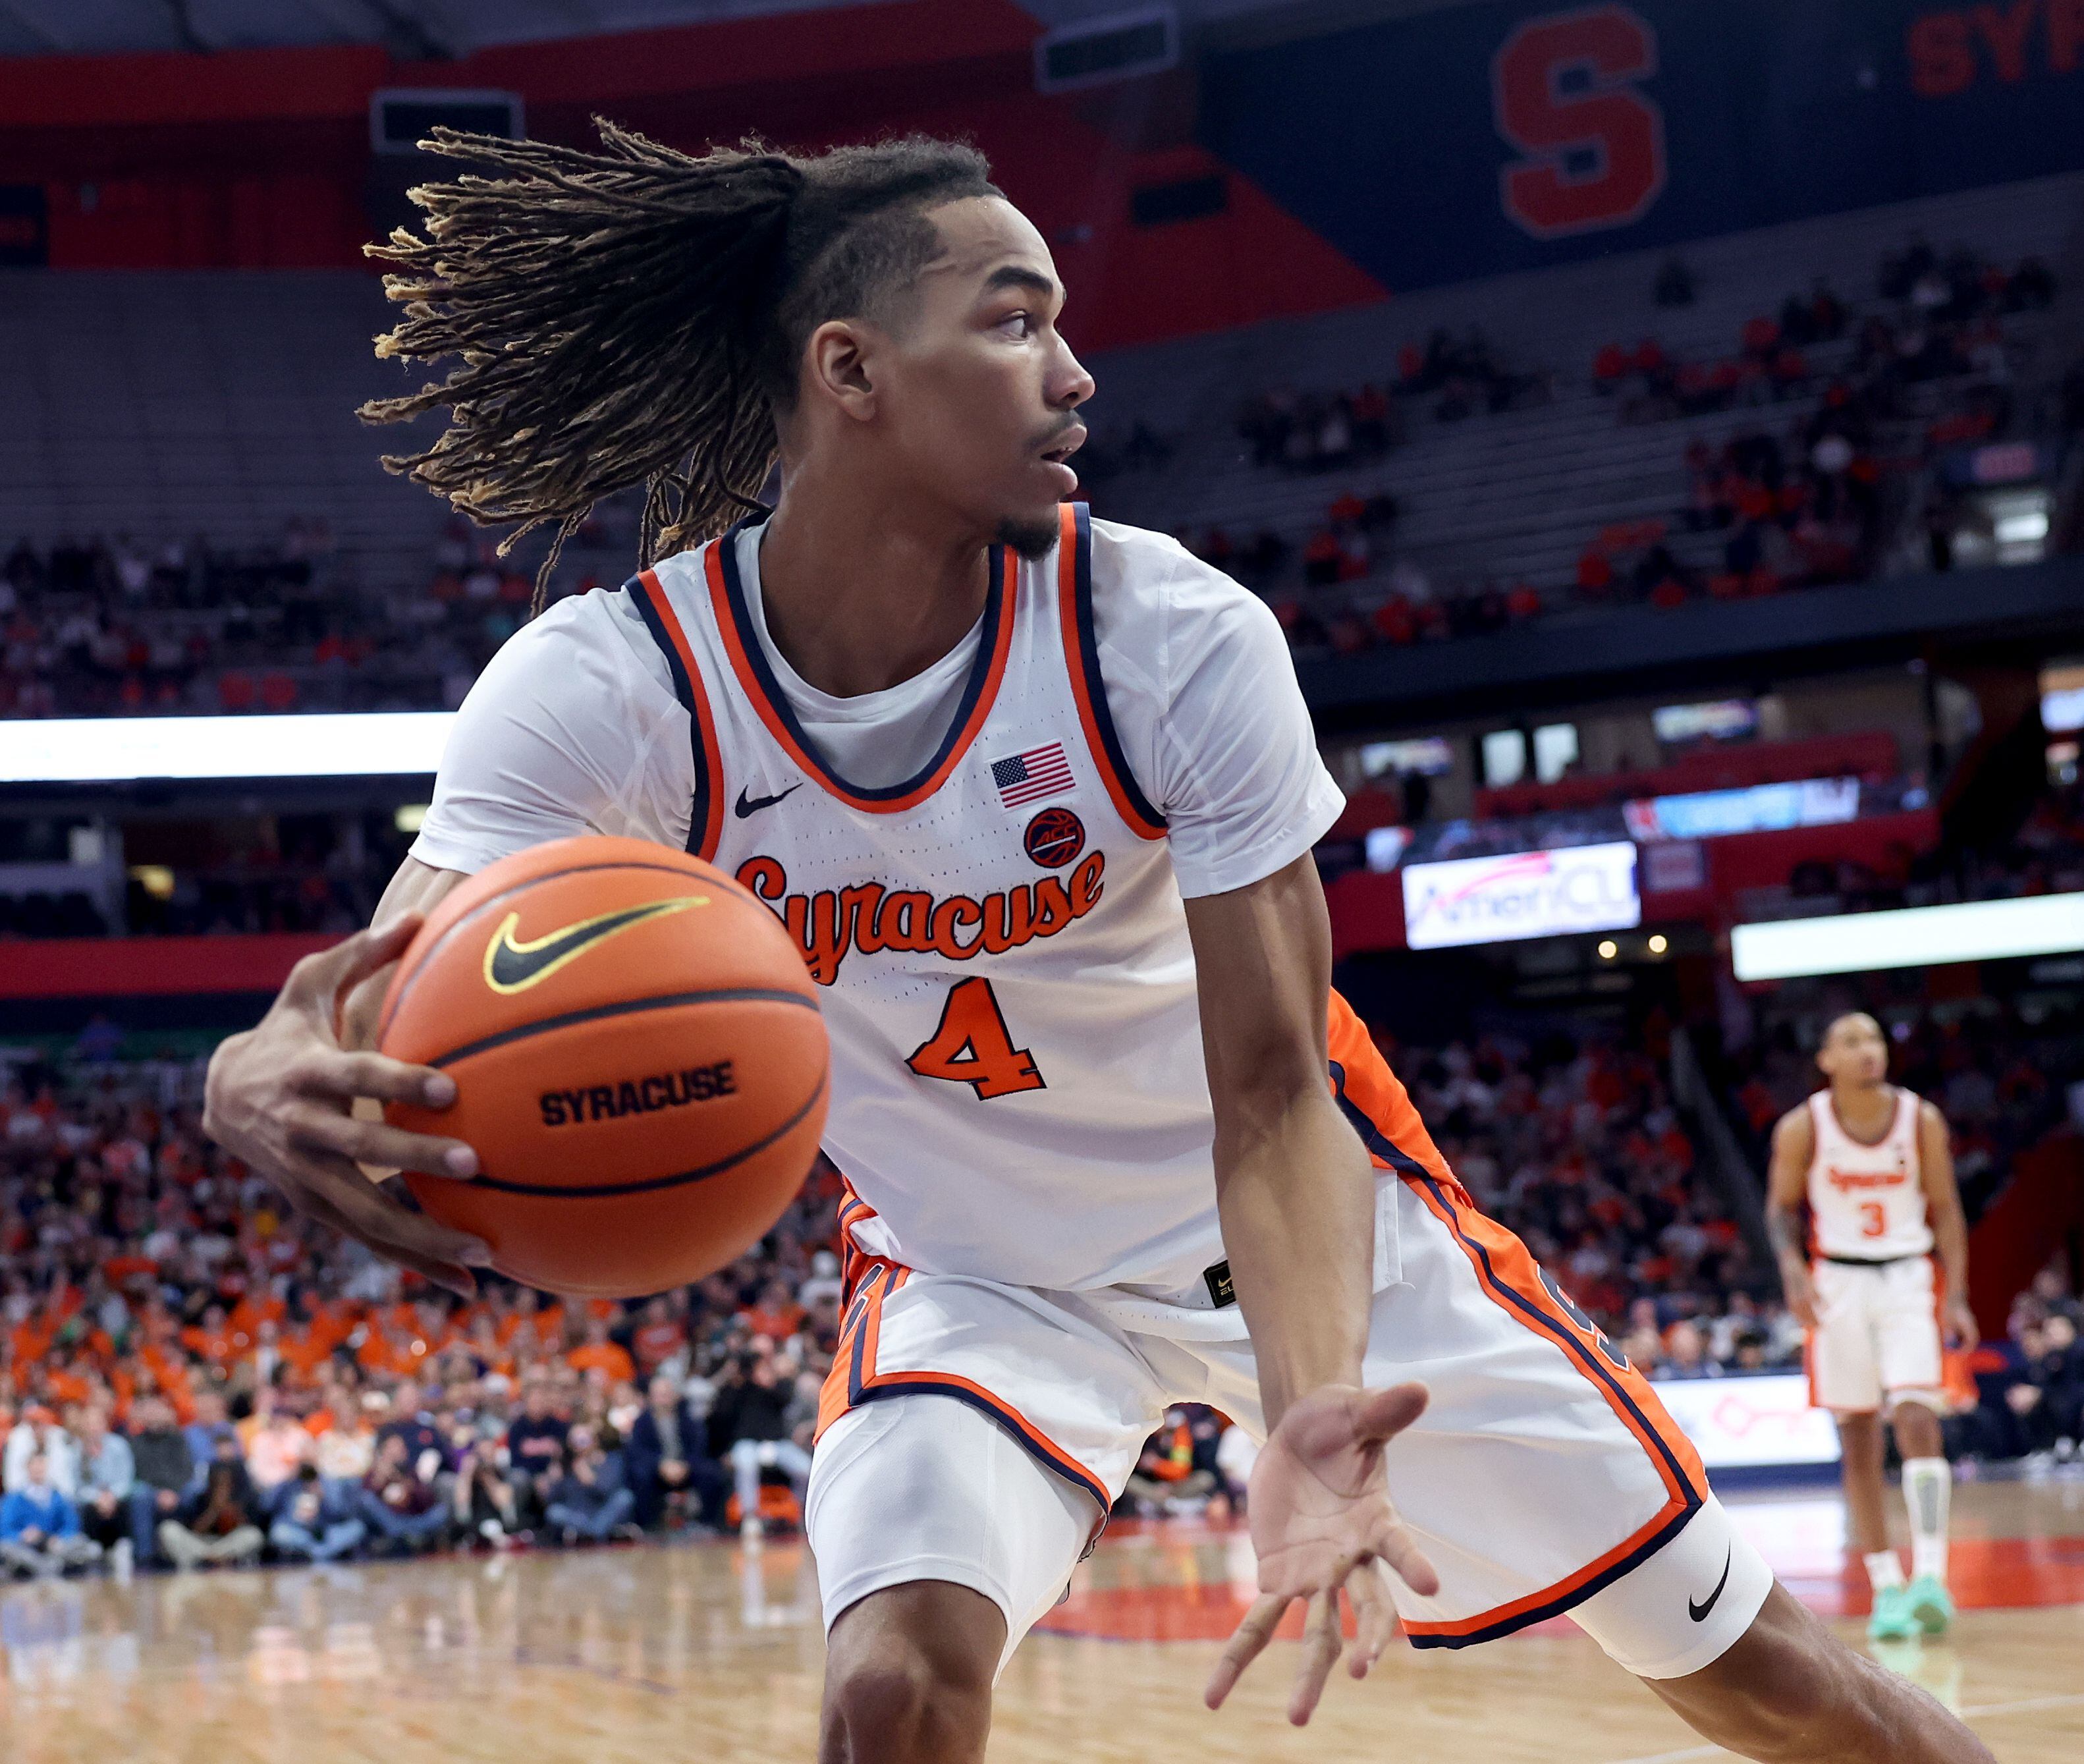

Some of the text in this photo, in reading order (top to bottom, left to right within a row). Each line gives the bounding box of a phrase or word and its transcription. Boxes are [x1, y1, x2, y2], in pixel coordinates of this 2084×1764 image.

[1491, 5, 1666, 239] S
[904, 976, 1047, 1101] 4
[539, 1060, 736, 1126] SYRACUSE
[1860, 1202, 1886, 1237] 3
[1220, 1286, 1234, 1296] EL
